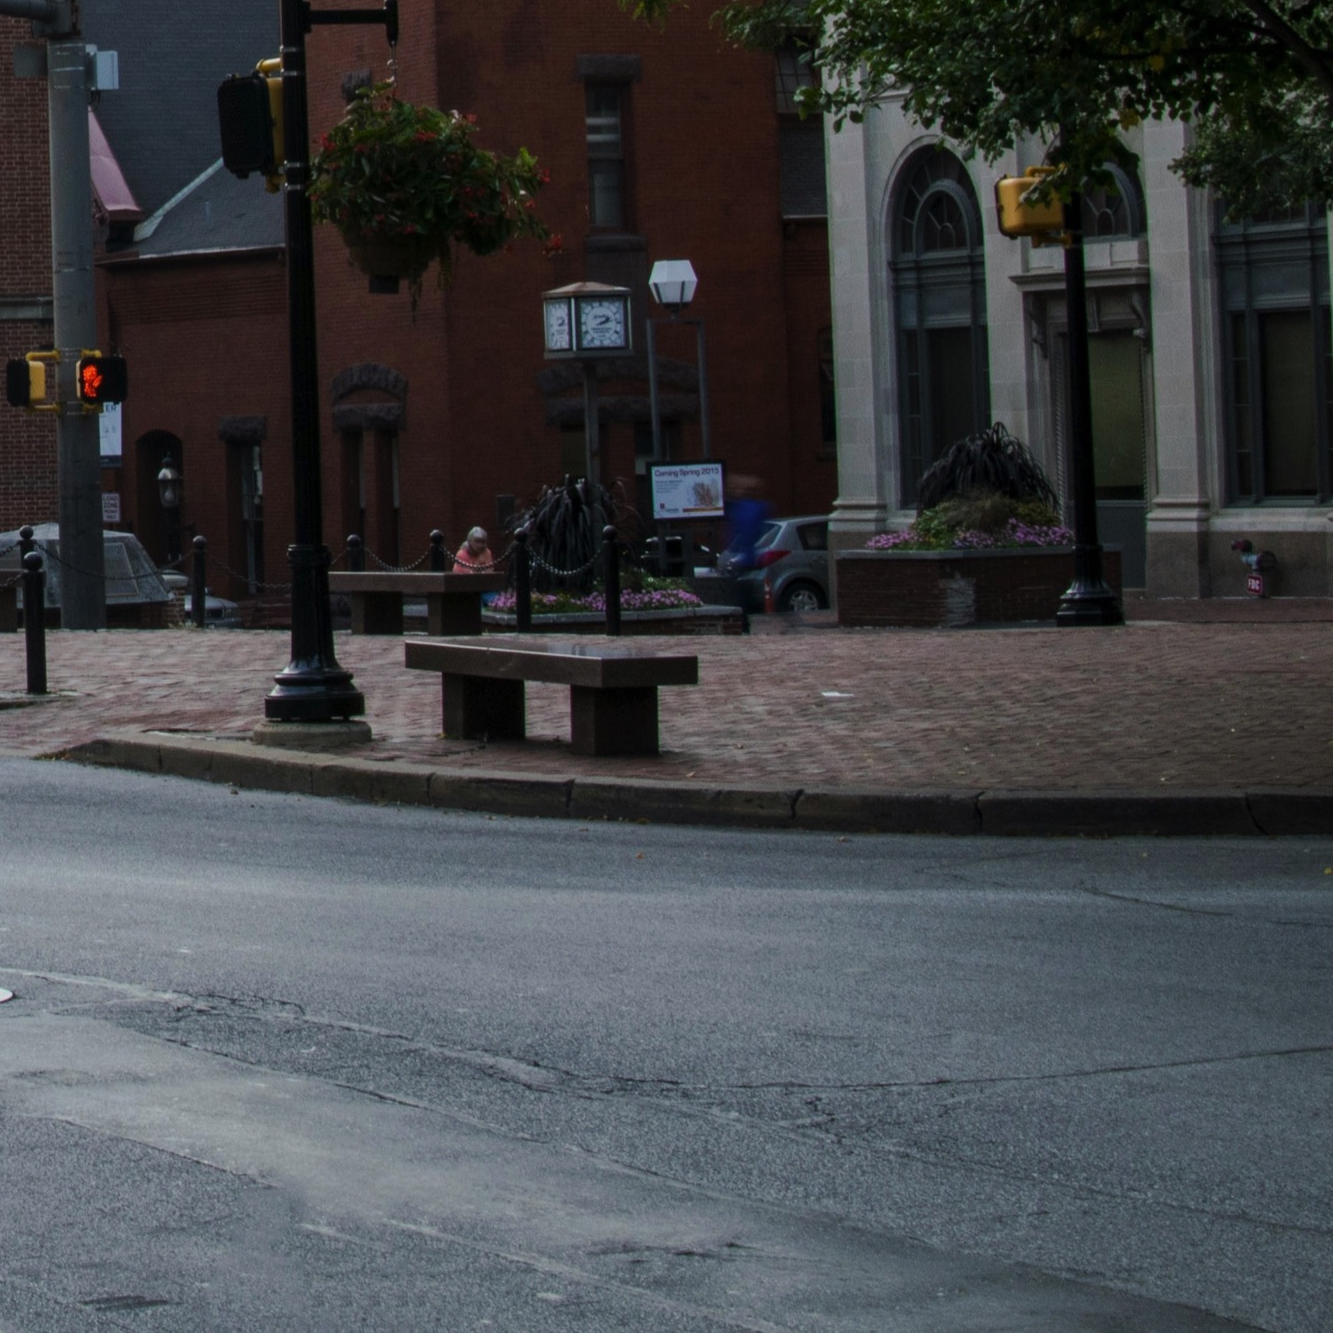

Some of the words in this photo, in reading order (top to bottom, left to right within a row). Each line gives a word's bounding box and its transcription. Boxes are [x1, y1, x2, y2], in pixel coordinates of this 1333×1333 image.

[654, 469, 678, 477] Coming
[679, 468, 700, 477] Spring
[701, 467, 719, 475] 2015
